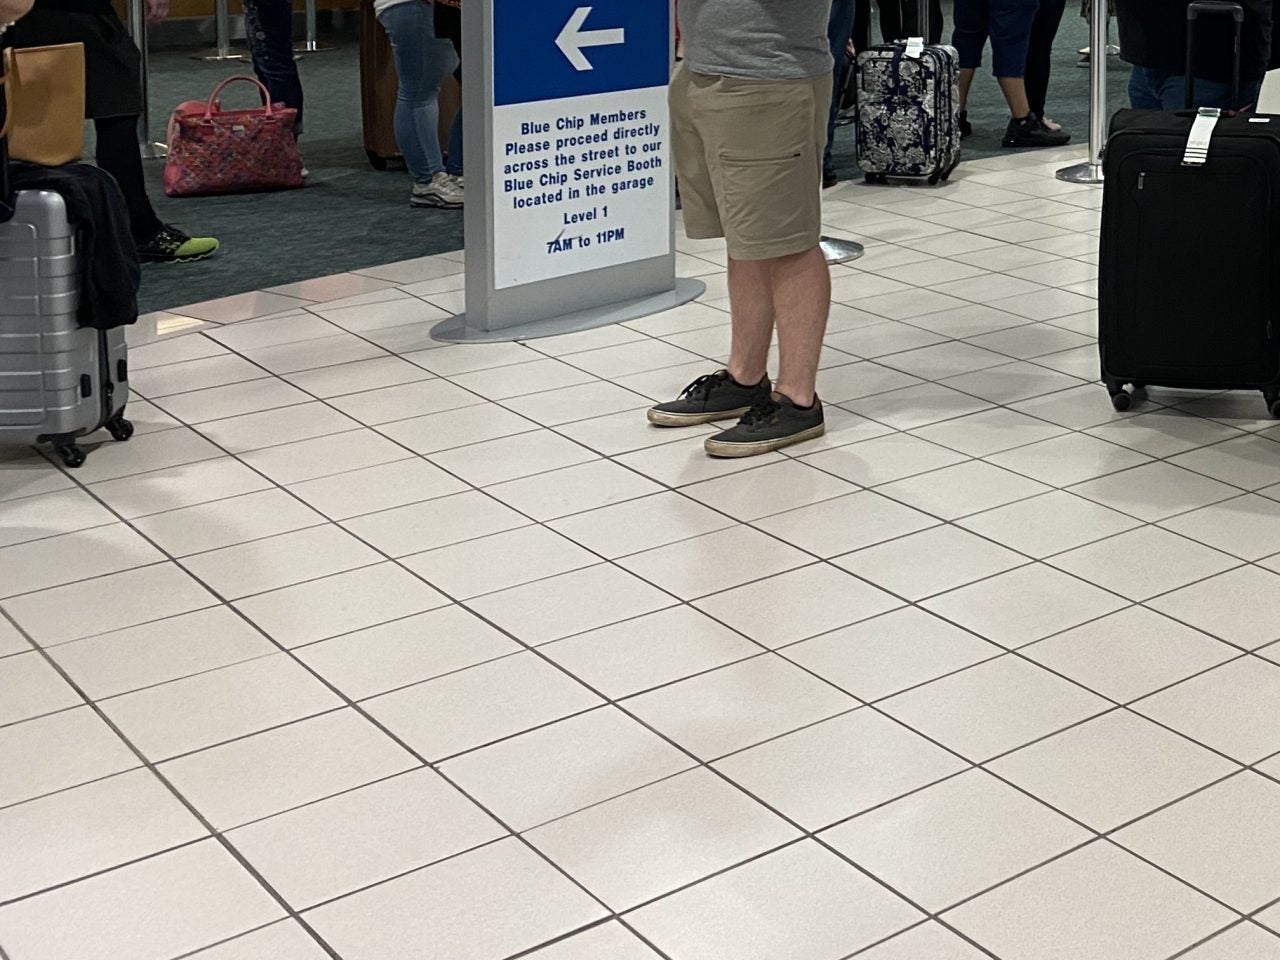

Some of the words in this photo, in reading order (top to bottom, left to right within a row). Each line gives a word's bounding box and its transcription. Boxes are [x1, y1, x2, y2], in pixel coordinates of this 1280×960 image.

[521, 121, 550, 135] Blue
[556, 116, 584, 130] Chip
[590, 109, 646, 125] Members
[505, 140, 550, 156] Please
[556, 130, 608, 151] proceed
[613, 123, 660, 140] directly
[504, 158, 548, 174] across
[555, 153, 575, 167] the
[581, 146, 619, 162] street
[625, 144, 637, 156] to
[642, 141, 662, 153] our
[504, 178, 533, 192] Blue
[539, 172, 568, 187] Chip
[573, 163, 622, 181] Service
[627, 156, 662, 172] Booth
[513, 189, 562, 209] located
[568, 187, 580, 200] in
[586, 183, 606, 197] the
[611, 176, 654, 194] garage
[564, 207, 597, 224] Level
[602, 205, 608, 218] 1
[546, 237, 573, 254] 7AM
[578, 236, 591, 248] to
[596, 227, 625, 244] 11PM
